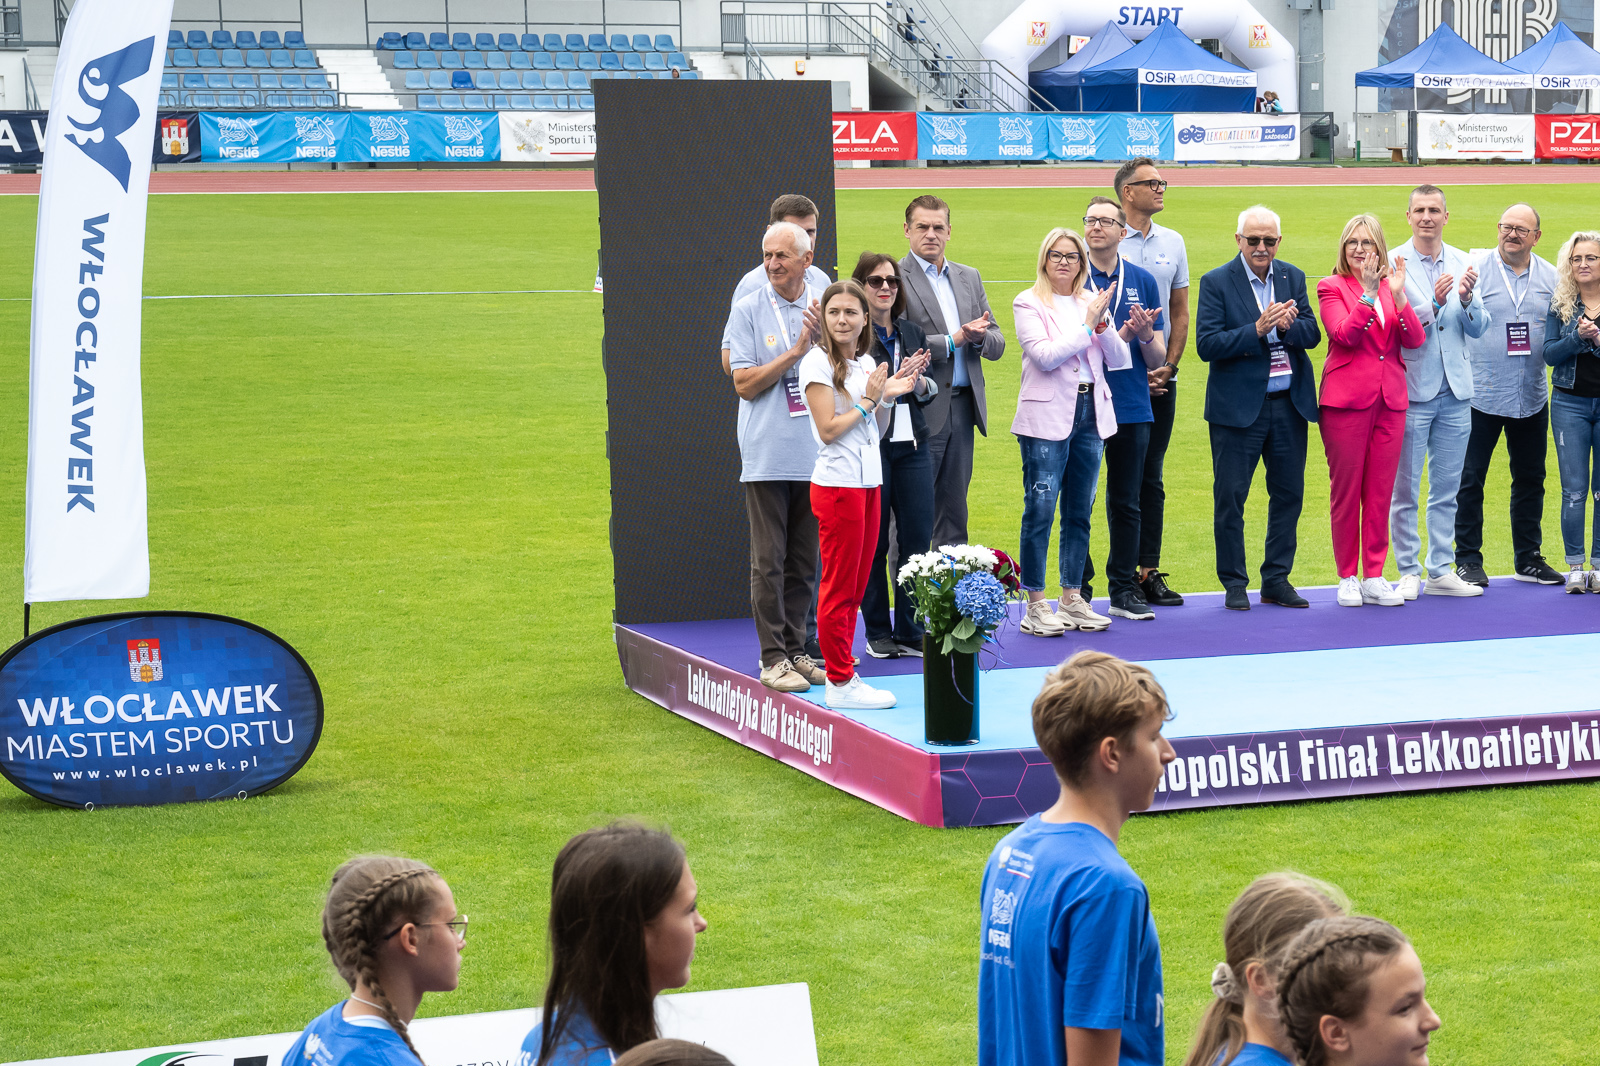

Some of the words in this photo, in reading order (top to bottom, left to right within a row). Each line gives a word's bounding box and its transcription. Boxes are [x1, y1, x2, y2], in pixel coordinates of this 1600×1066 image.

[1117, 6, 1184, 26] START
[1145, 71, 1176, 84] OSiR
[1421, 76, 1453, 87] OSiR
[1540, 77, 1571, 88] OSiR
[548, 123, 597, 132] Ministerst
[832, 120, 899, 144] ZLA
[1457, 123, 1508, 132] Ministerstwo
[548, 135, 580, 146] Sportu
[1457, 135, 1483, 145] Sportu
[1490, 135, 1524, 145] Turystyki
[219, 146, 259, 159] Nestlé
[296, 146, 336, 158] Nestlé
[371, 145, 410, 158] Nestlé
[445, 145, 484, 158] Nestlé
[932, 144, 967, 156] Nestlé
[999, 144, 1033, 156] Nestlé
[1062, 144, 1096, 156] Nestlé
[1127, 144, 1160, 156] Nestlé
[66, 212, 110, 514] WŁOCŁAWEK
[17, 683, 282, 727] WŁOCŁAWEK
[687, 664, 759, 731] Lekkoatletyka
[761, 696, 778, 741] dla
[780, 703, 834, 766] każdego!
[6, 730, 156, 761] MIASTEM
[166, 719, 295, 754] SPORTU
[1299, 735, 1378, 782] Finał
[1386, 720, 1600, 775] Lekkoatletyki
[53, 755, 259, 781] www.wloclawek.pl
